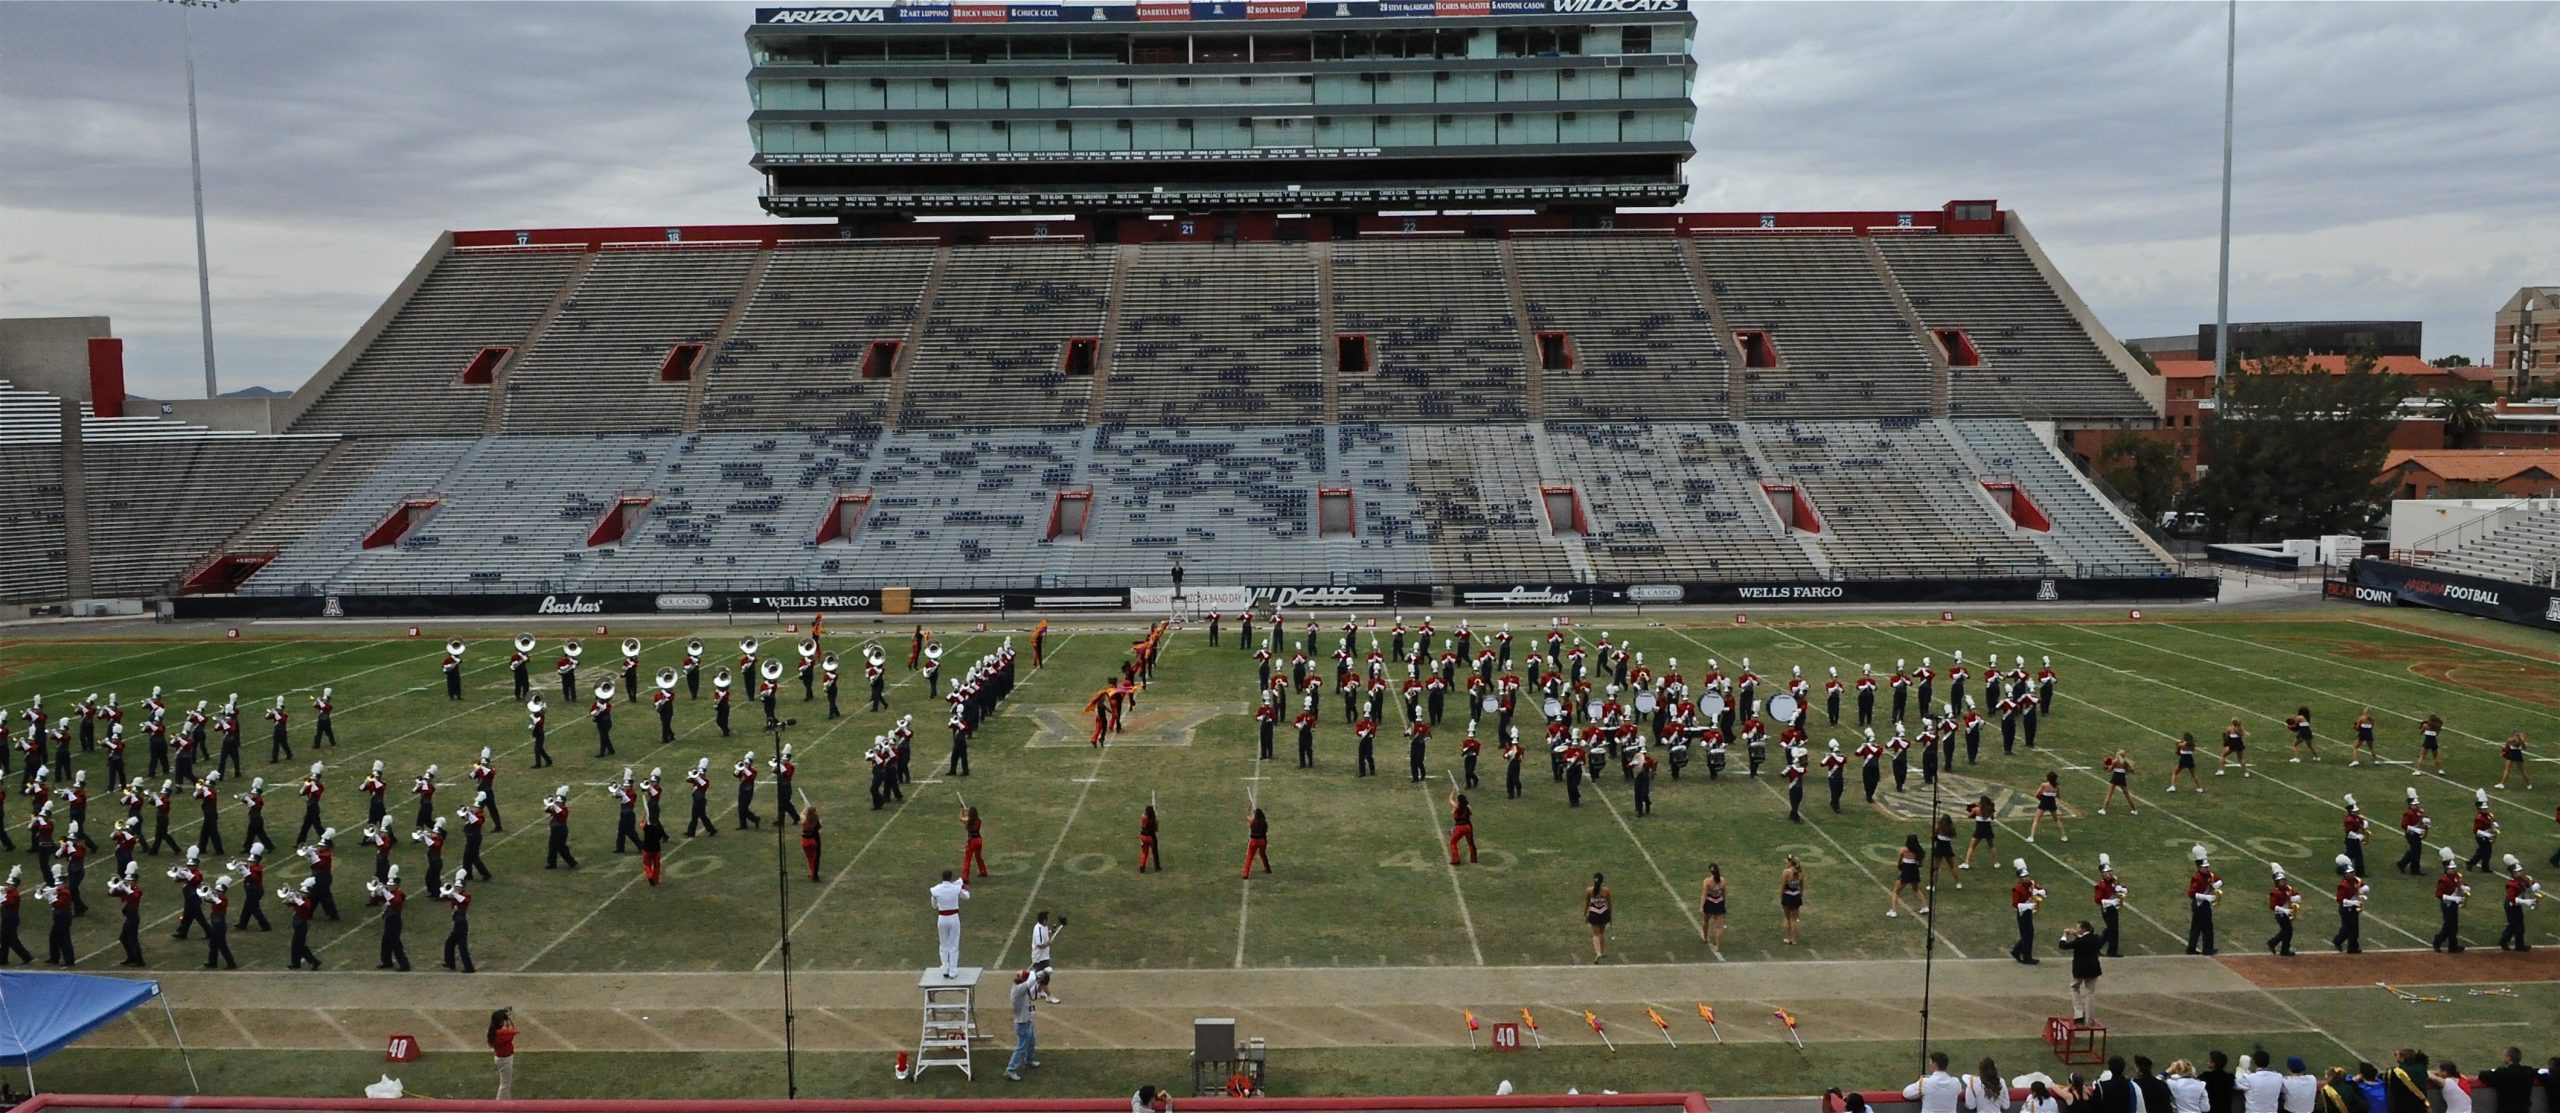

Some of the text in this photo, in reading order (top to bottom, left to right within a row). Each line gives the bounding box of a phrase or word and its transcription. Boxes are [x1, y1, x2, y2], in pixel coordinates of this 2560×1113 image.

[1554, 0, 1680, 12] WILDCATS
[769, 9, 884, 23] ARIZONA
[1600, 221, 1613, 229] 23
[1761, 220, 1773, 228] 24
[1898, 218, 1912, 227] 25
[1034, 228, 1047, 237] 20
[1182, 225, 1193, 234] 21
[1404, 224, 1416, 232] 22
[668, 233, 679, 242] 18
[841, 230, 851, 239] 19
[518, 236, 528, 245] 17
[162, 404, 172, 413] 16
[1738, 587, 1843, 598] WELLS FARGO
[2356, 587, 2392, 604] DOWN
[2444, 584, 2500, 605] FOOTBALL
[766, 596, 870, 607] WELLS FARGO
[1133, 594, 1168, 604] UNIVERSITY
[1182, 593, 1209, 603] RIZONA
[1209, 593, 1228, 603] BAND
[1229, 593, 1242, 602] DAY
[538, 595, 603, 613] Bashas'
[1496, 1028, 1515, 1046] 40
[388, 1038, 408, 1058] 40
